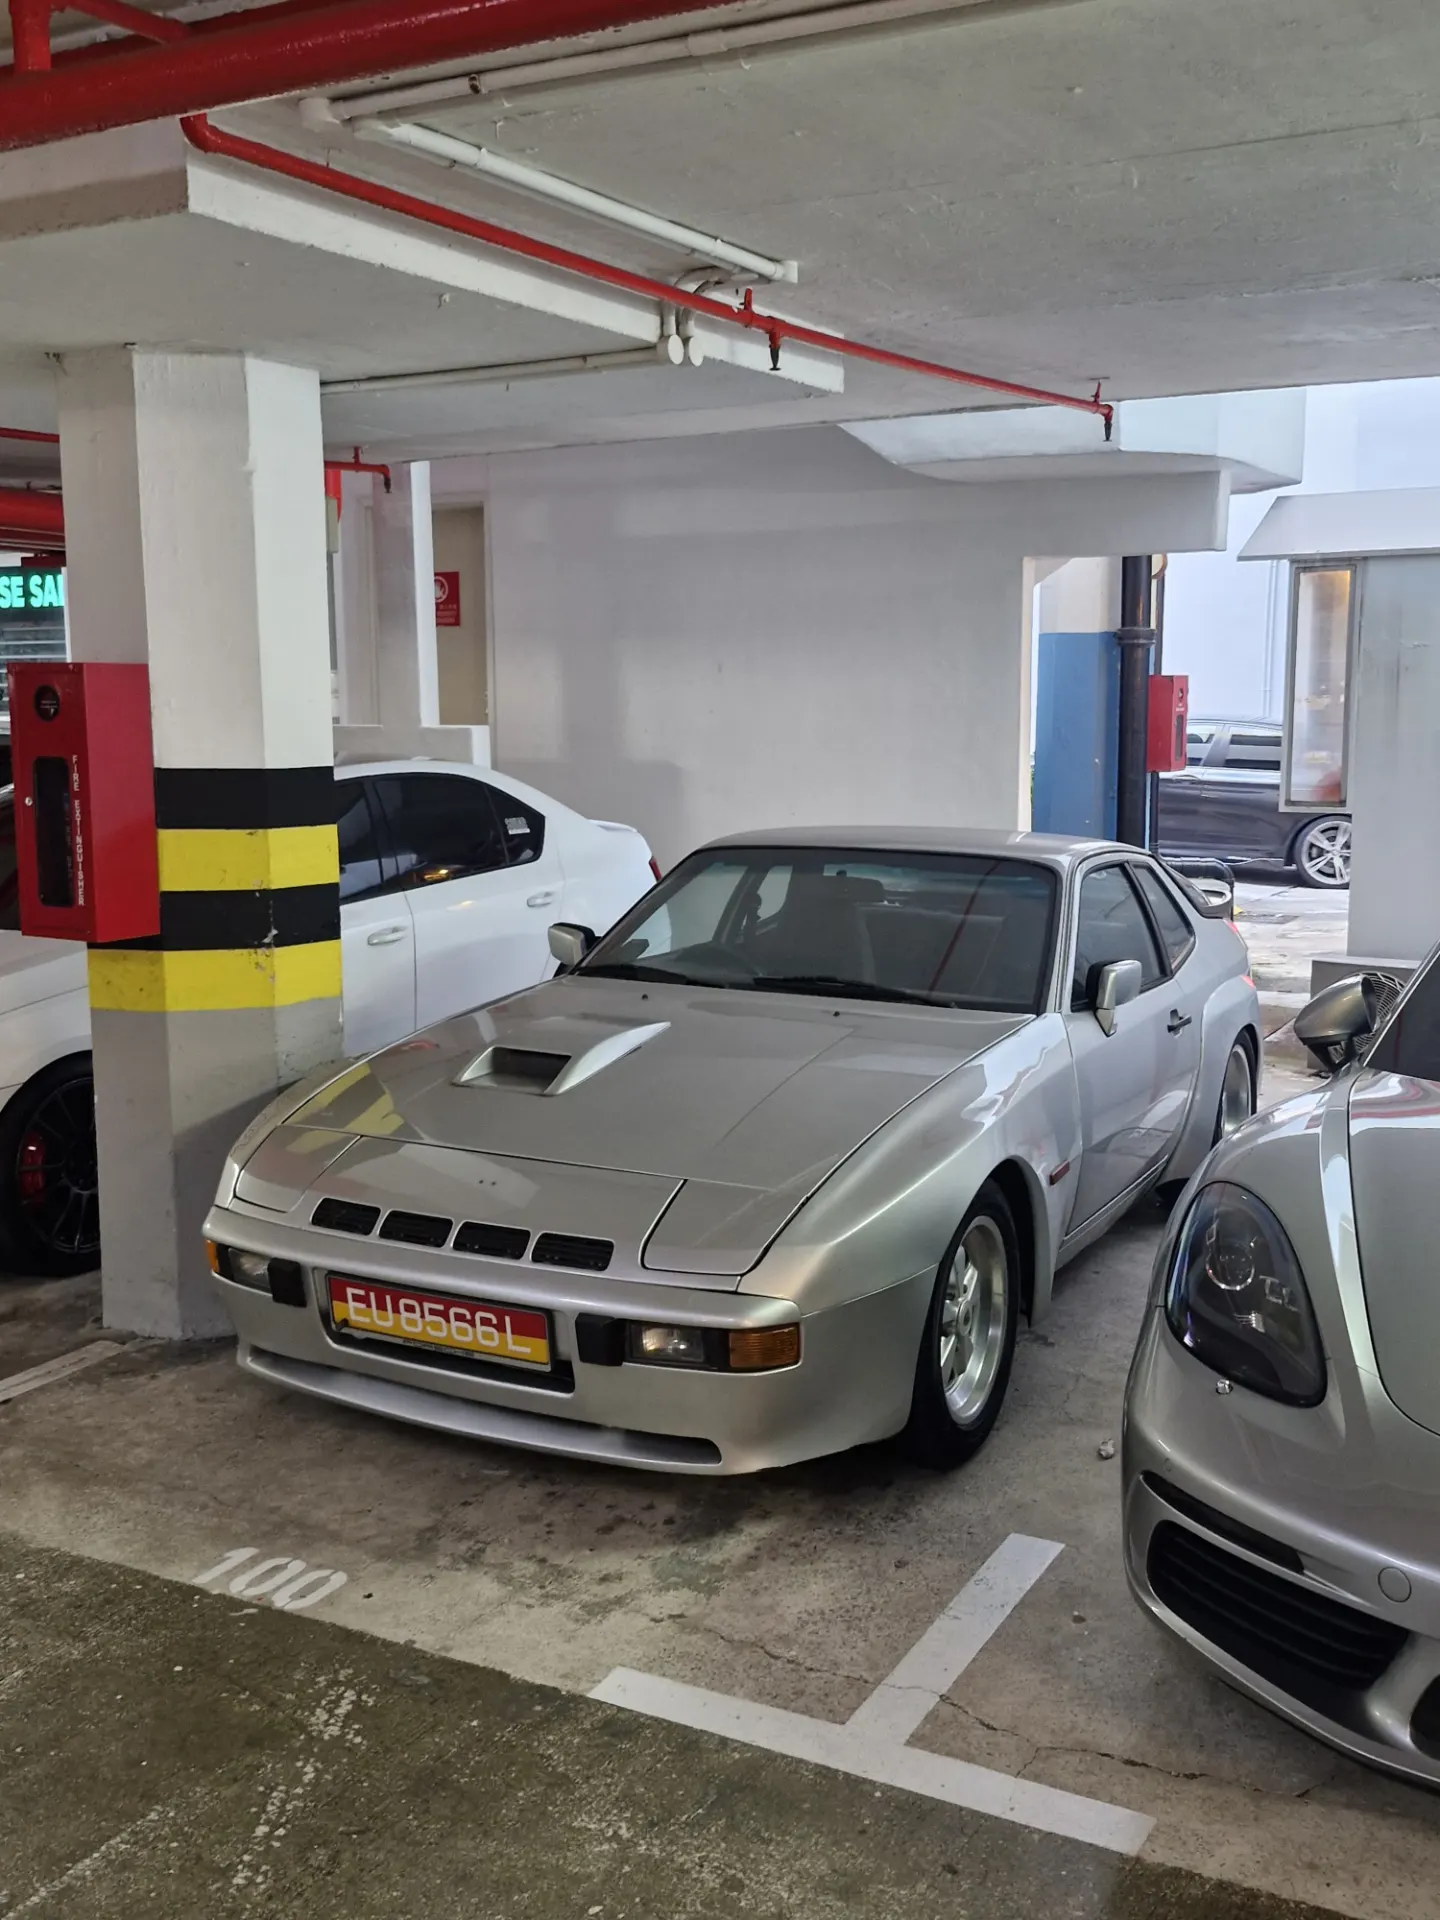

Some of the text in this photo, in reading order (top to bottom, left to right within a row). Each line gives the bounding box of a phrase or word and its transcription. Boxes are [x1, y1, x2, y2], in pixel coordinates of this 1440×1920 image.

[72, 754, 85, 906] FIRE EXTINGUISHER
[346, 1286, 532, 1354] EU8566L
[193, 1547, 347, 1610] 100
